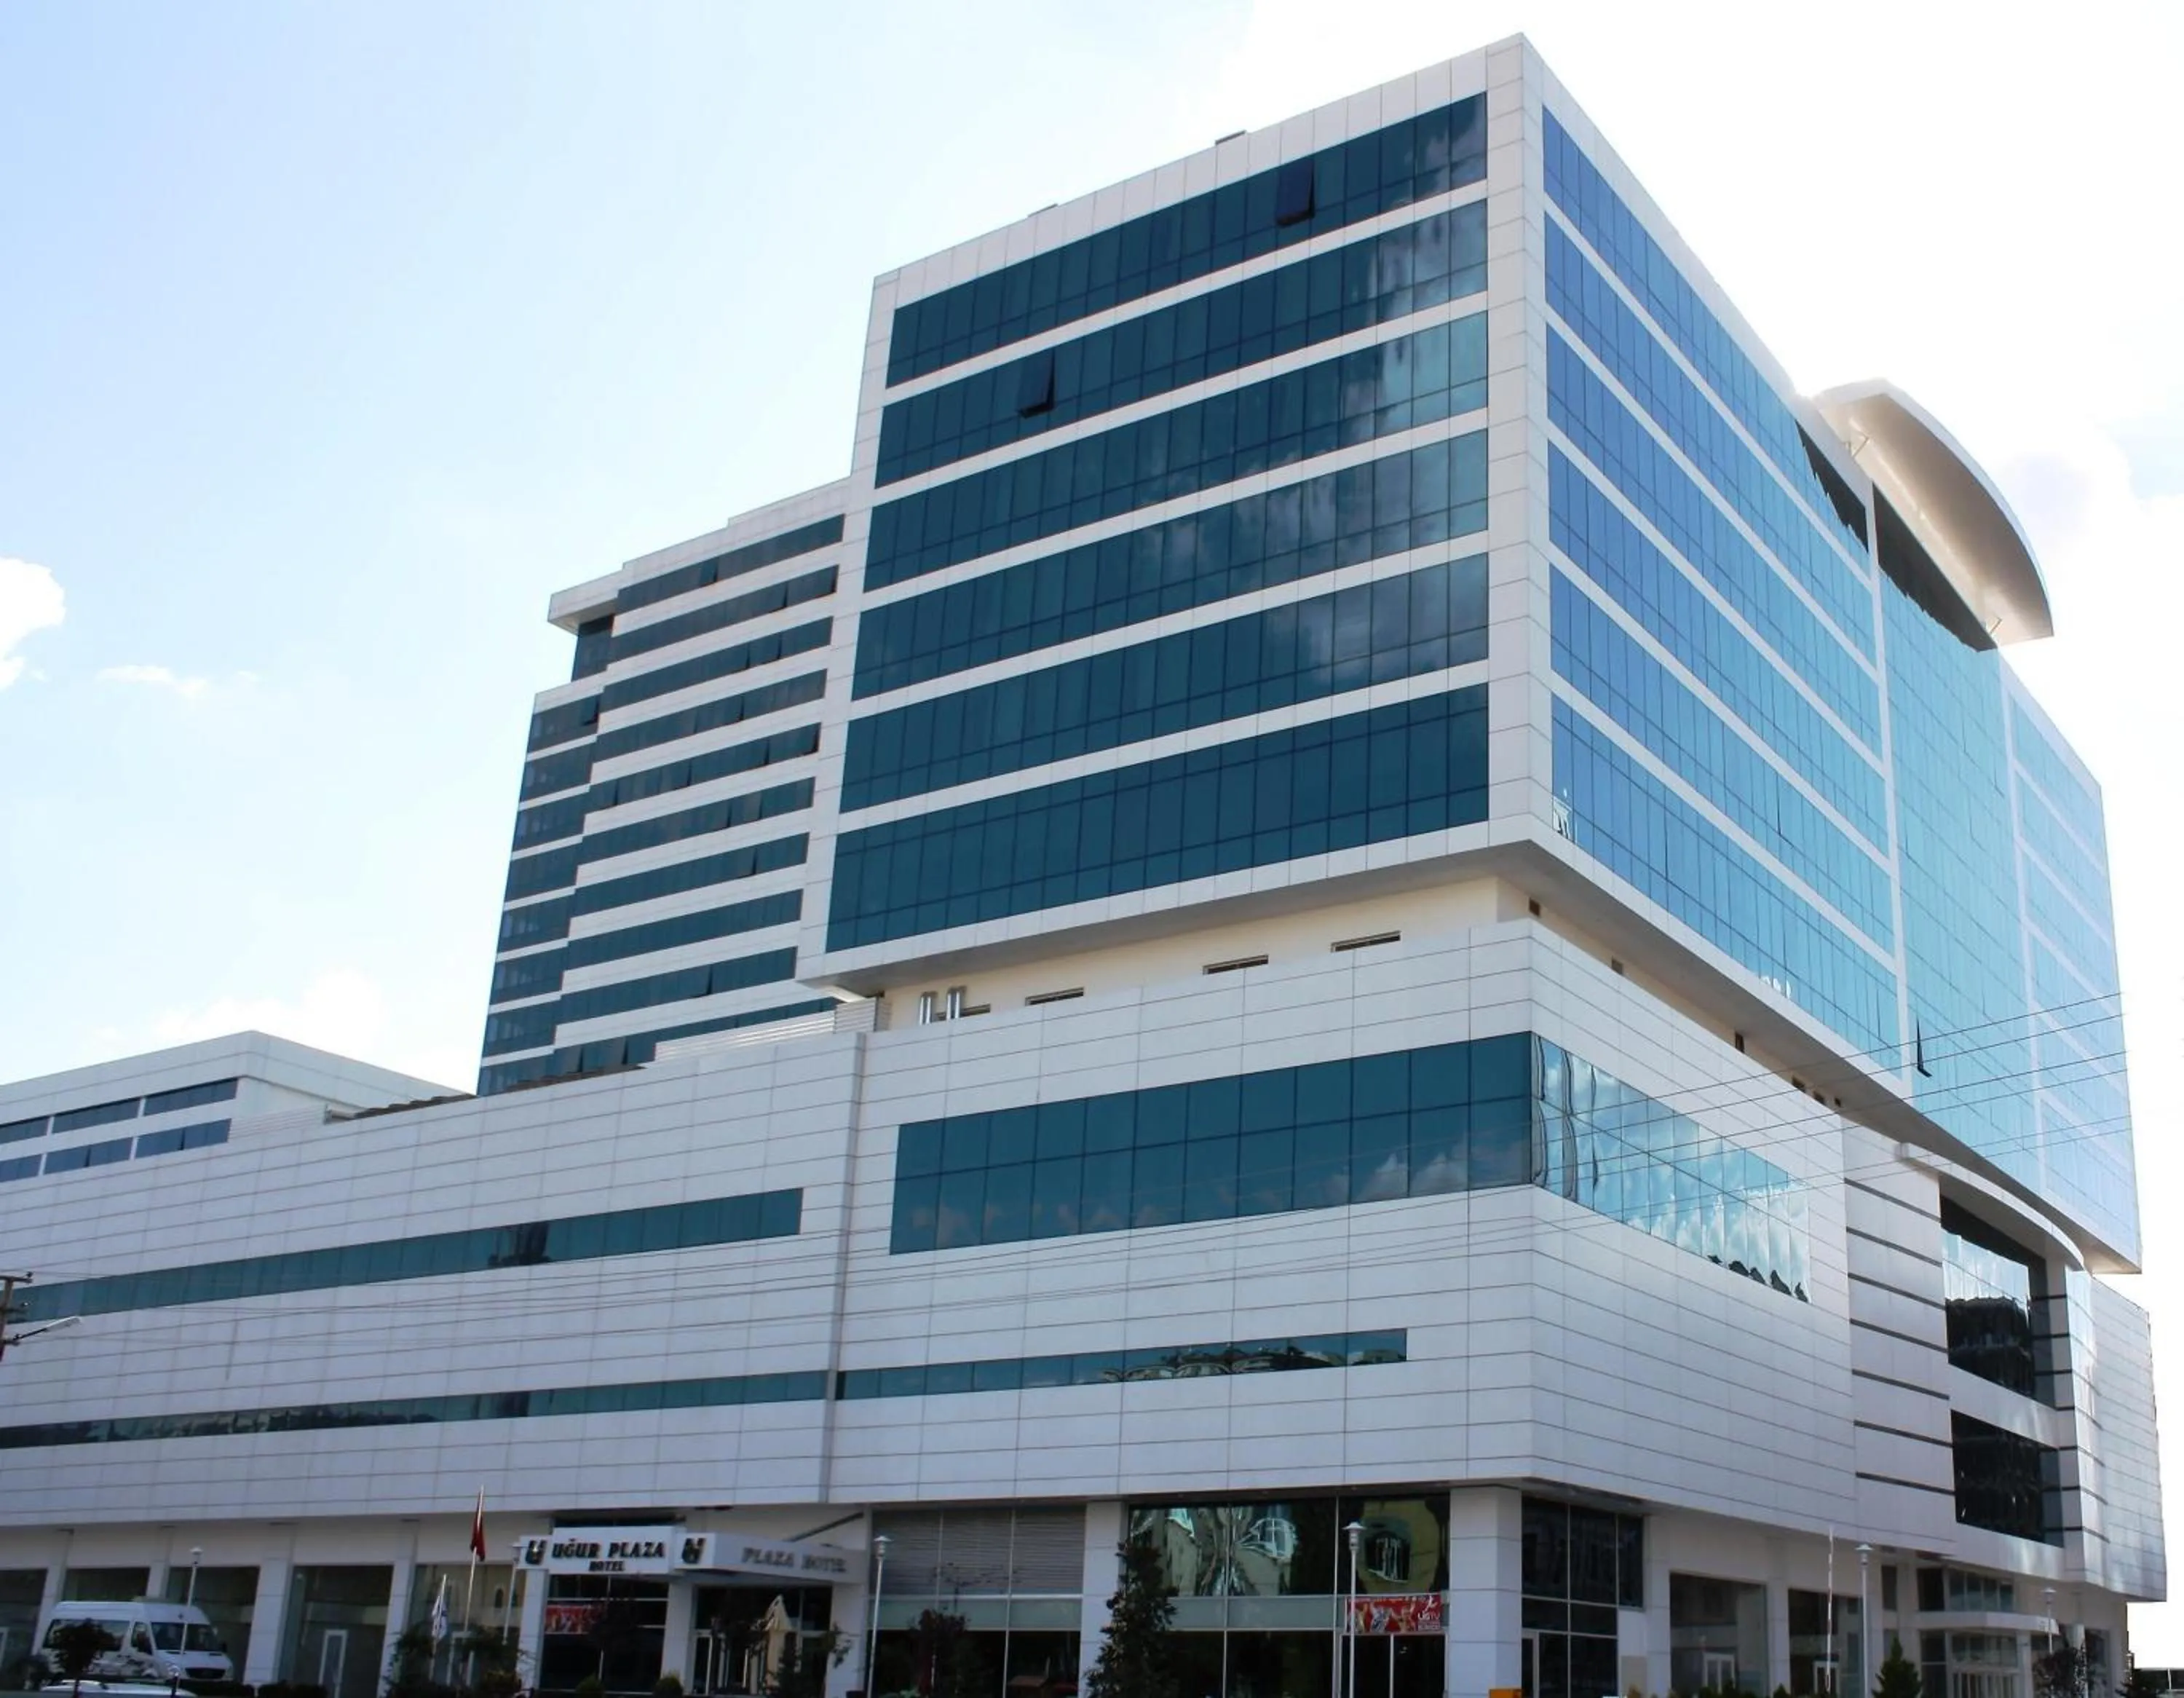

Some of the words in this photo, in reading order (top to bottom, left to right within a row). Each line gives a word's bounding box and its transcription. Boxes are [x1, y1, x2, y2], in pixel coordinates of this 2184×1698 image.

[552, 1539, 601, 1558] UĞUR
[607, 1541, 666, 1557] PLAZA
[588, 1560, 625, 1572] HOTEL
[741, 1547, 794, 1567] PLAZA
[802, 1554, 847, 1573] HOTEL
